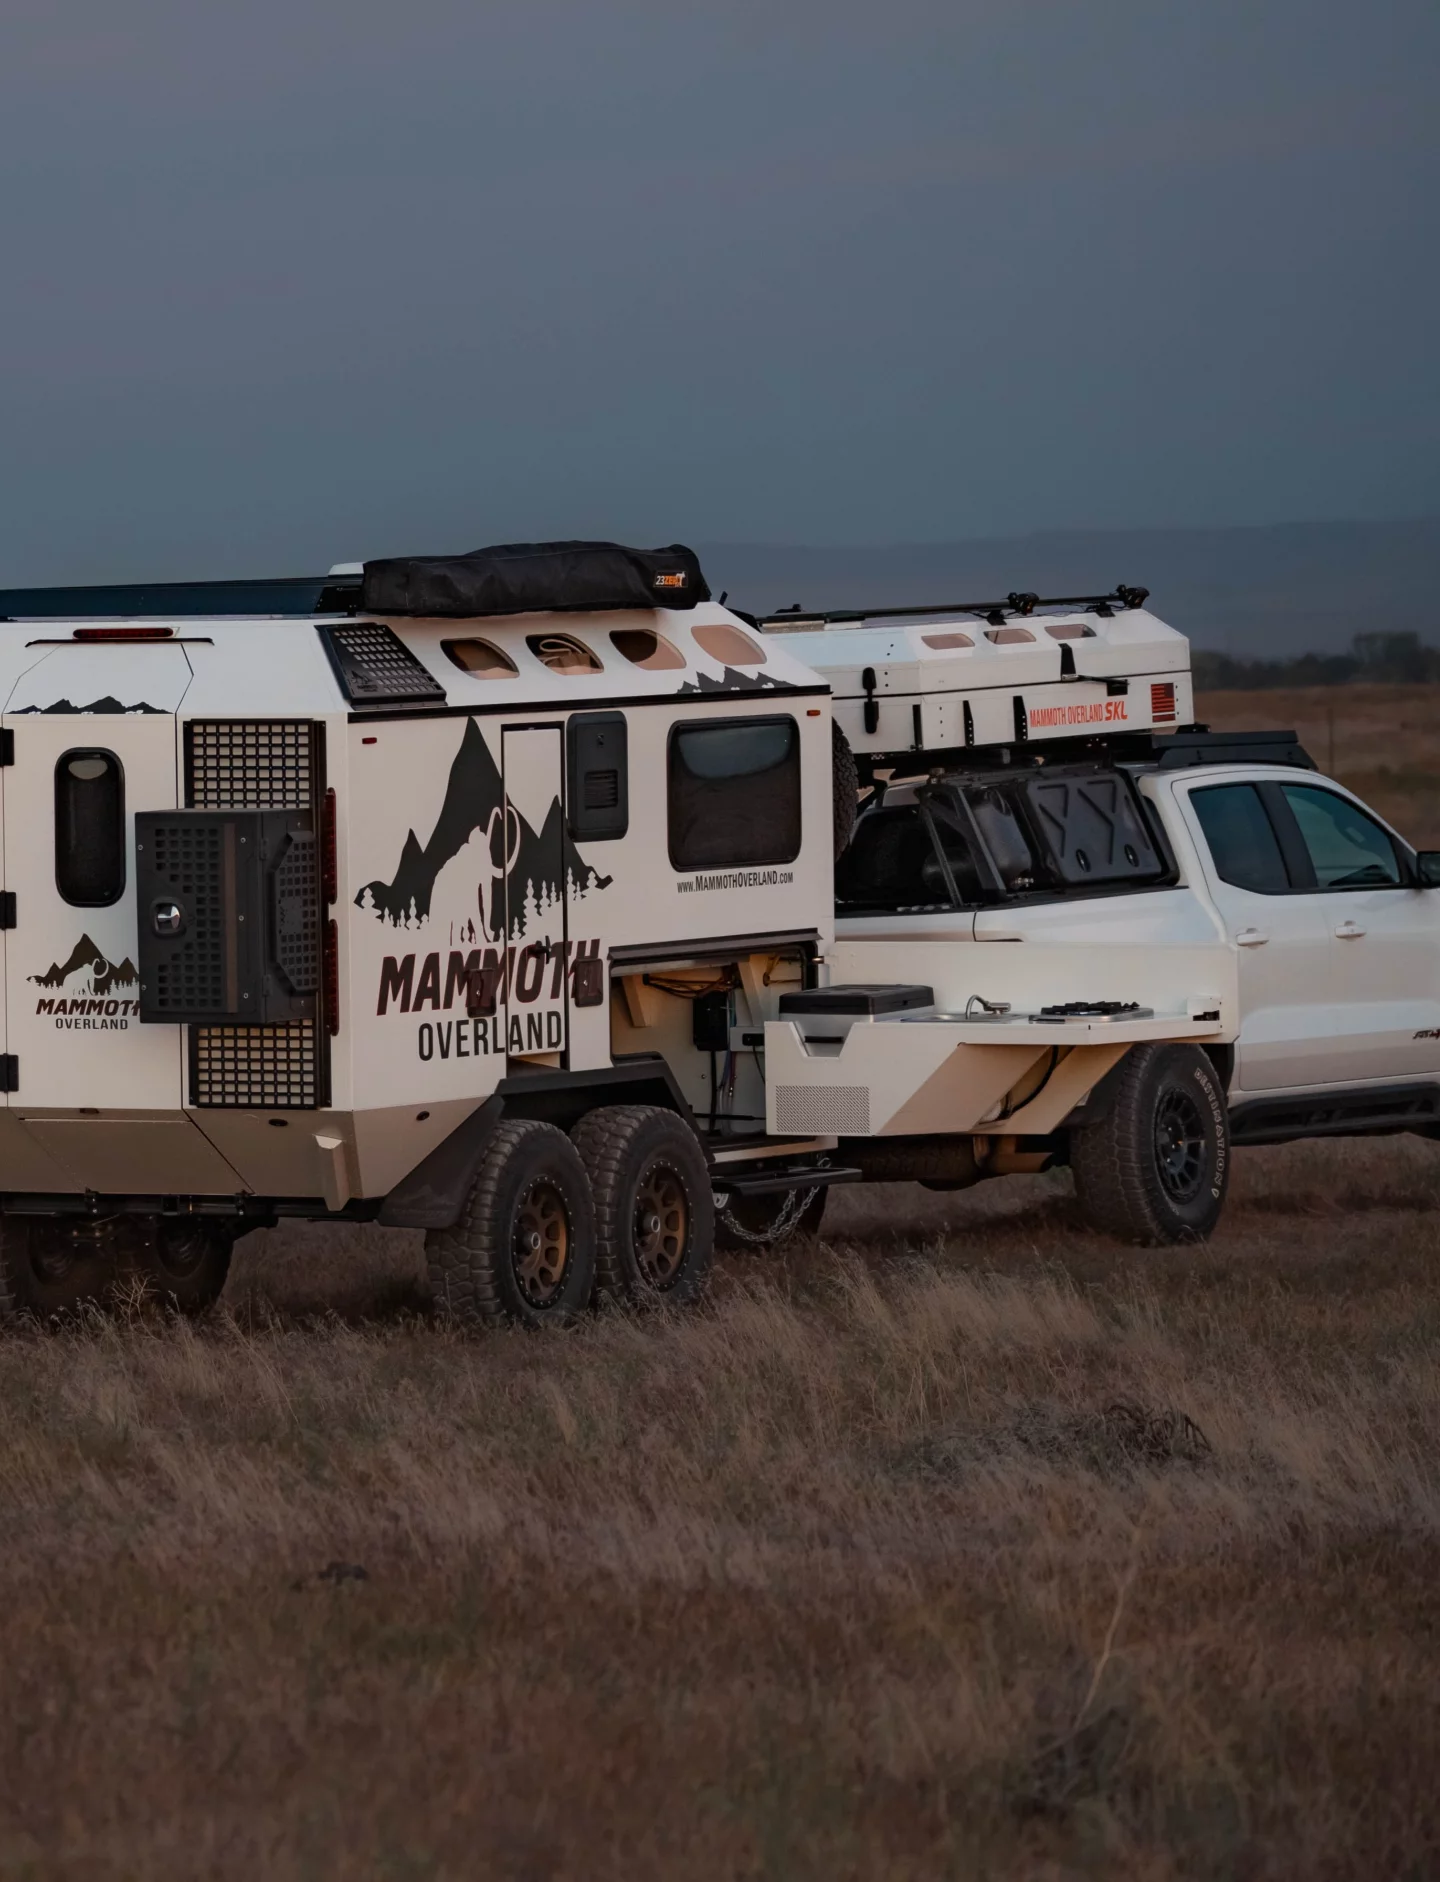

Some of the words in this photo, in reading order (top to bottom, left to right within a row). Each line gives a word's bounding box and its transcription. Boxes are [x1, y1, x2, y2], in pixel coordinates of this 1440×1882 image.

[1030, 707, 1066, 727] MAMMOTH
[1068, 704, 1103, 724] OVERLAND
[1105, 701, 1128, 721] SKL
[56, 1018, 128, 1029] OVERLAND
[418, 1011, 561, 1061] OVERLAND
[1194, 1067, 1225, 1185] DESTINATION
